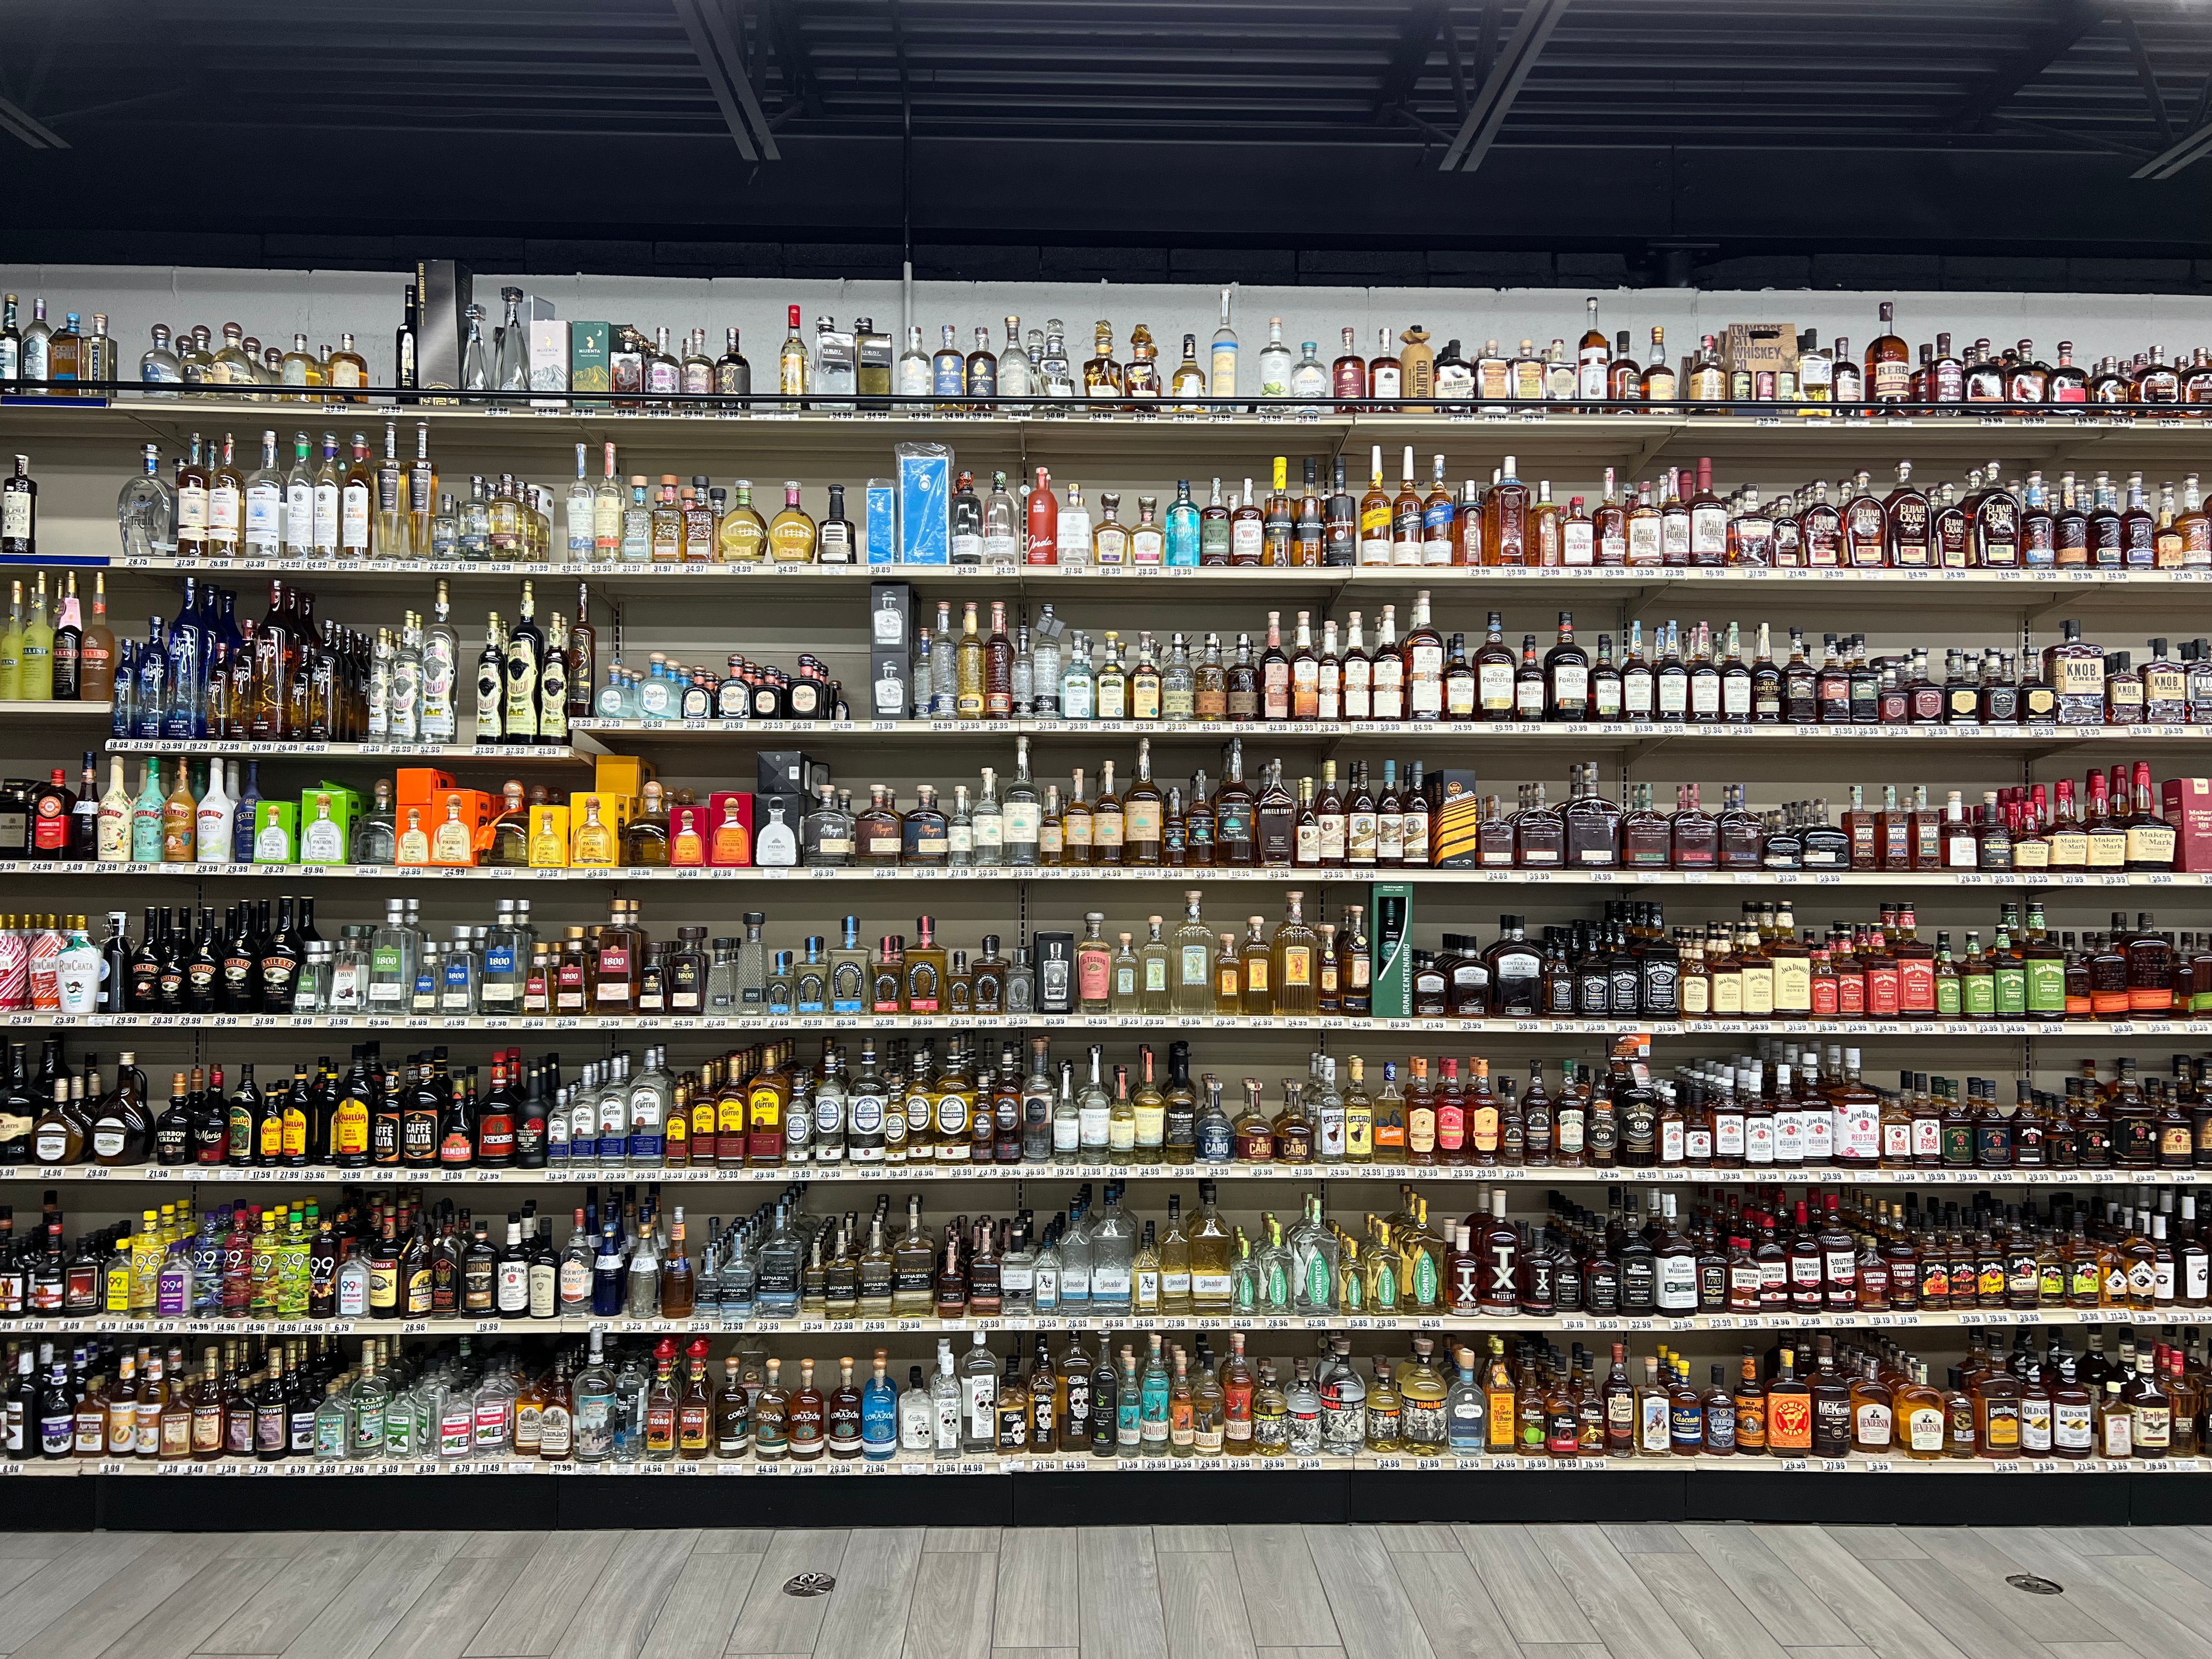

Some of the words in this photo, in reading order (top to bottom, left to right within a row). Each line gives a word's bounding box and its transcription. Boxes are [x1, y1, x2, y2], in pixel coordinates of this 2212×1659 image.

[1731, 324, 1782, 335] TRAVERSE
[1732, 336, 1756, 347] CITY
[1733, 347, 1781, 359] WHISKEY
[1734, 360, 1750, 371] CO.
[1857, 509, 1881, 517] ELIJAH
[1899, 504, 1925, 514] ELIJAH
[129, 516, 155, 529] Tequila
[1857, 516, 1881, 525] CRAIG
[1899, 512, 1925, 523] CRAIG
[1703, 520, 1723, 528] WILD
[1700, 527, 1724, 537] TURKEY
[1028, 533, 1053, 554] Onda
[2067, 663, 2097, 678] KNOB
[1482, 676, 1513, 684] FORESTER
[1558, 676, 1587, 684] FORESTER
[2154, 676, 2178, 686] KNOB
[198, 810, 224, 820] BAILEYS
[2148, 838, 2172, 846] Mark
[261, 958, 296, 970] BAILEYS
[377, 956, 396, 965] 1800
[489, 957, 510, 966] 1800
[604, 957, 624, 966] 1800
[1087, 956, 1105, 965] TESORO
[1502, 960, 1537, 968] GENTLEMAN
[635, 1099, 656, 1109] Cuervo
[754, 1099, 775, 1109] Cuervo
[1849, 1112, 1863, 1123] JIM
[1862, 1110, 1878, 1123] BEAM
[406, 1121, 431, 1133] CAFFÉ
[406, 1132, 431, 1144] LOLITA
[1380, 1128, 1401, 1138] Sauza
[483, 1133, 512, 1144] KAMORA
[1205, 1143, 1228, 1154] CABO
[1284, 1143, 1307, 1155] CABO
[135, 1253, 160, 1273] 99
[280, 1253, 304, 1273] 99
[311, 1257, 335, 1274] 99
[466, 1263, 492, 1273] GRIND
[1707, 1277, 1722, 1285] 1783
[1778, 1402, 1805, 1415] HOWLER
[791, 1412, 821, 1422] CORAZÓN
[864, 1412, 894, 1421] CORAZÓN
[1673, 1414, 1700, 1424] Cascade
[1860, 1418, 1889, 1429] HENDERSON
